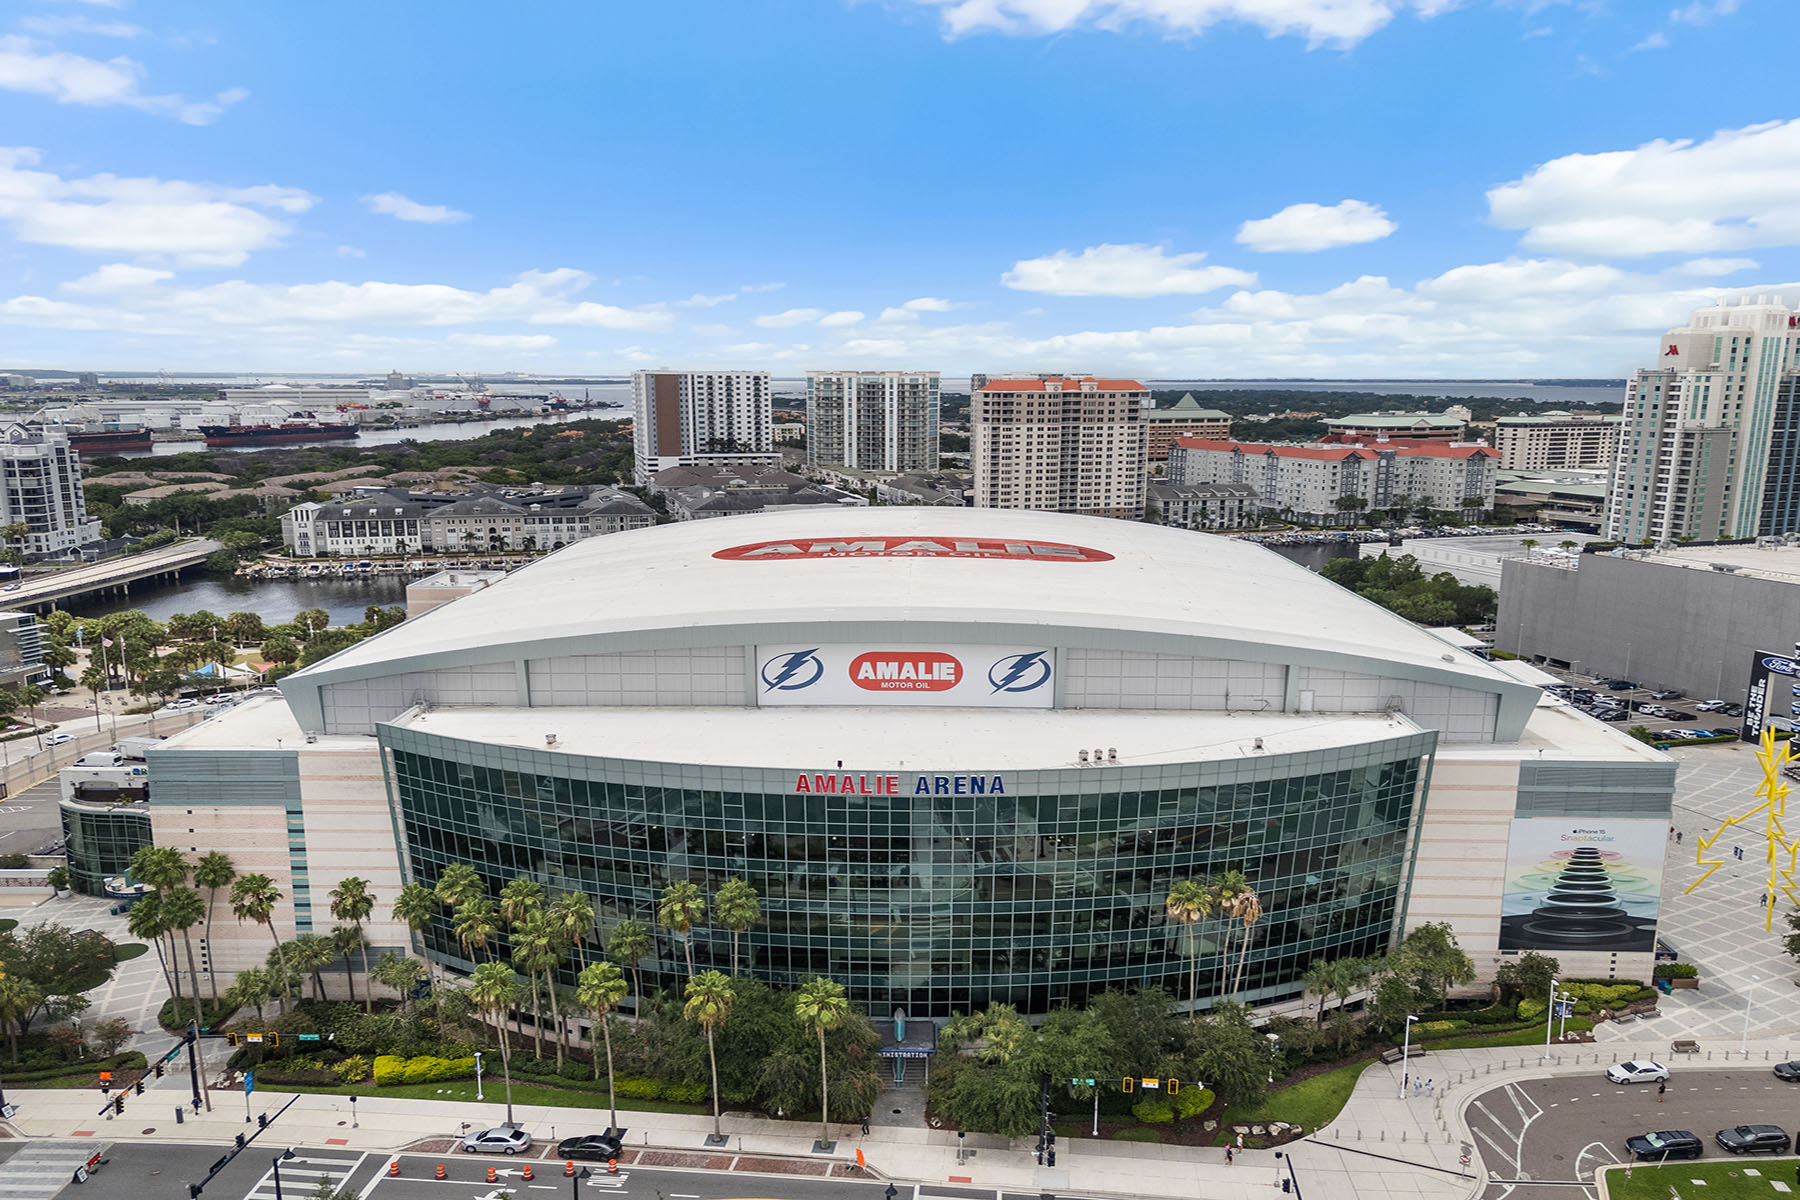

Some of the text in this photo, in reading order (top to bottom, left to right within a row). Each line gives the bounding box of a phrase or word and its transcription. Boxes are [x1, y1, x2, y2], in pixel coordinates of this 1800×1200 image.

[740, 541, 1088, 560] AMALIE
[857, 662, 955, 681] AMALIE
[1746, 685, 1758, 726] BE THE
[1751, 678, 1766, 736] THUNDER
[795, 773, 1005, 795] AMALIE ARENA
